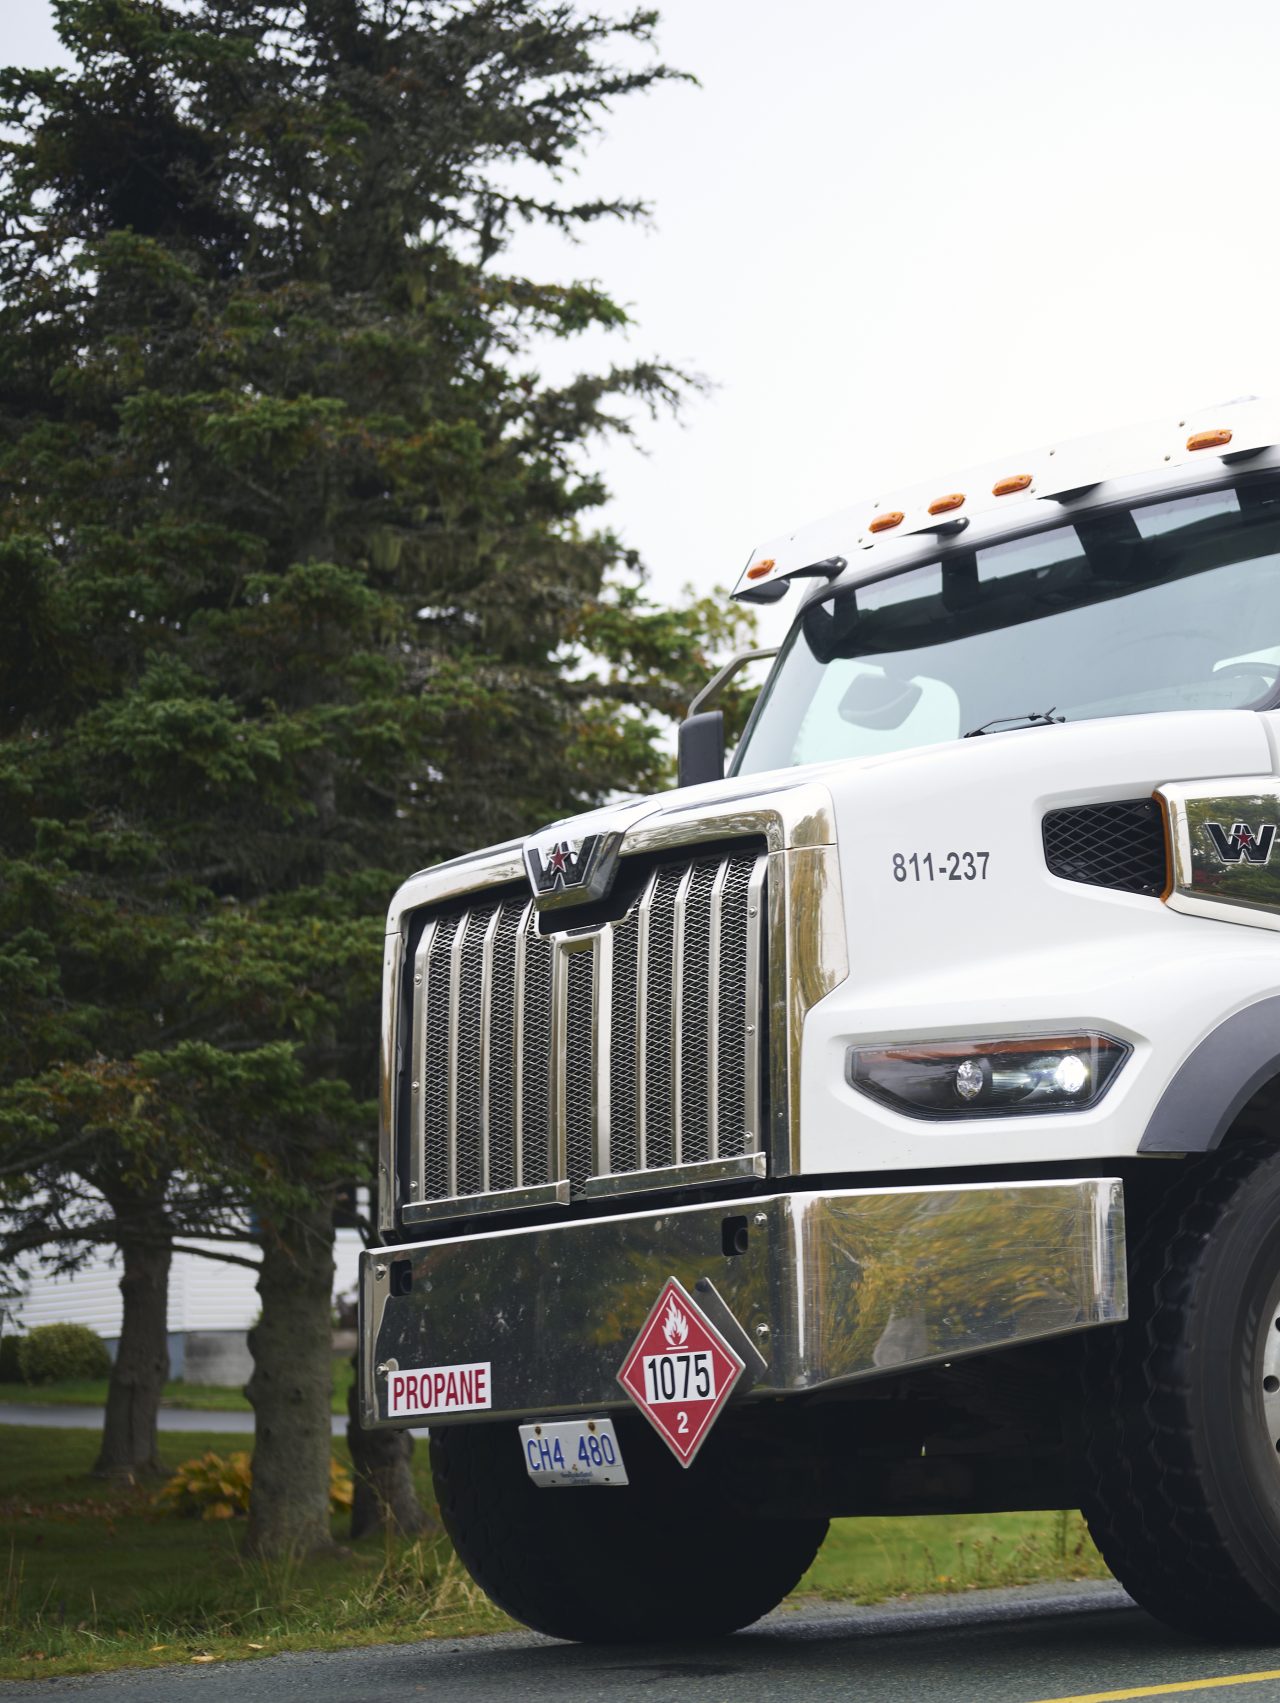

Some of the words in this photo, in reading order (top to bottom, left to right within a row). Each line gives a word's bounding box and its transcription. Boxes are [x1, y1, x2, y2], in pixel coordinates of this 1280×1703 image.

[892, 852, 990, 882] 811-237
[393, 1368, 487, 1411] PROPANE
[647, 1353, 711, 1401] 1075
[676, 1411, 689, 1434] 2
[526, 1437, 565, 1472] CH4
[577, 1432, 617, 1470] 480
